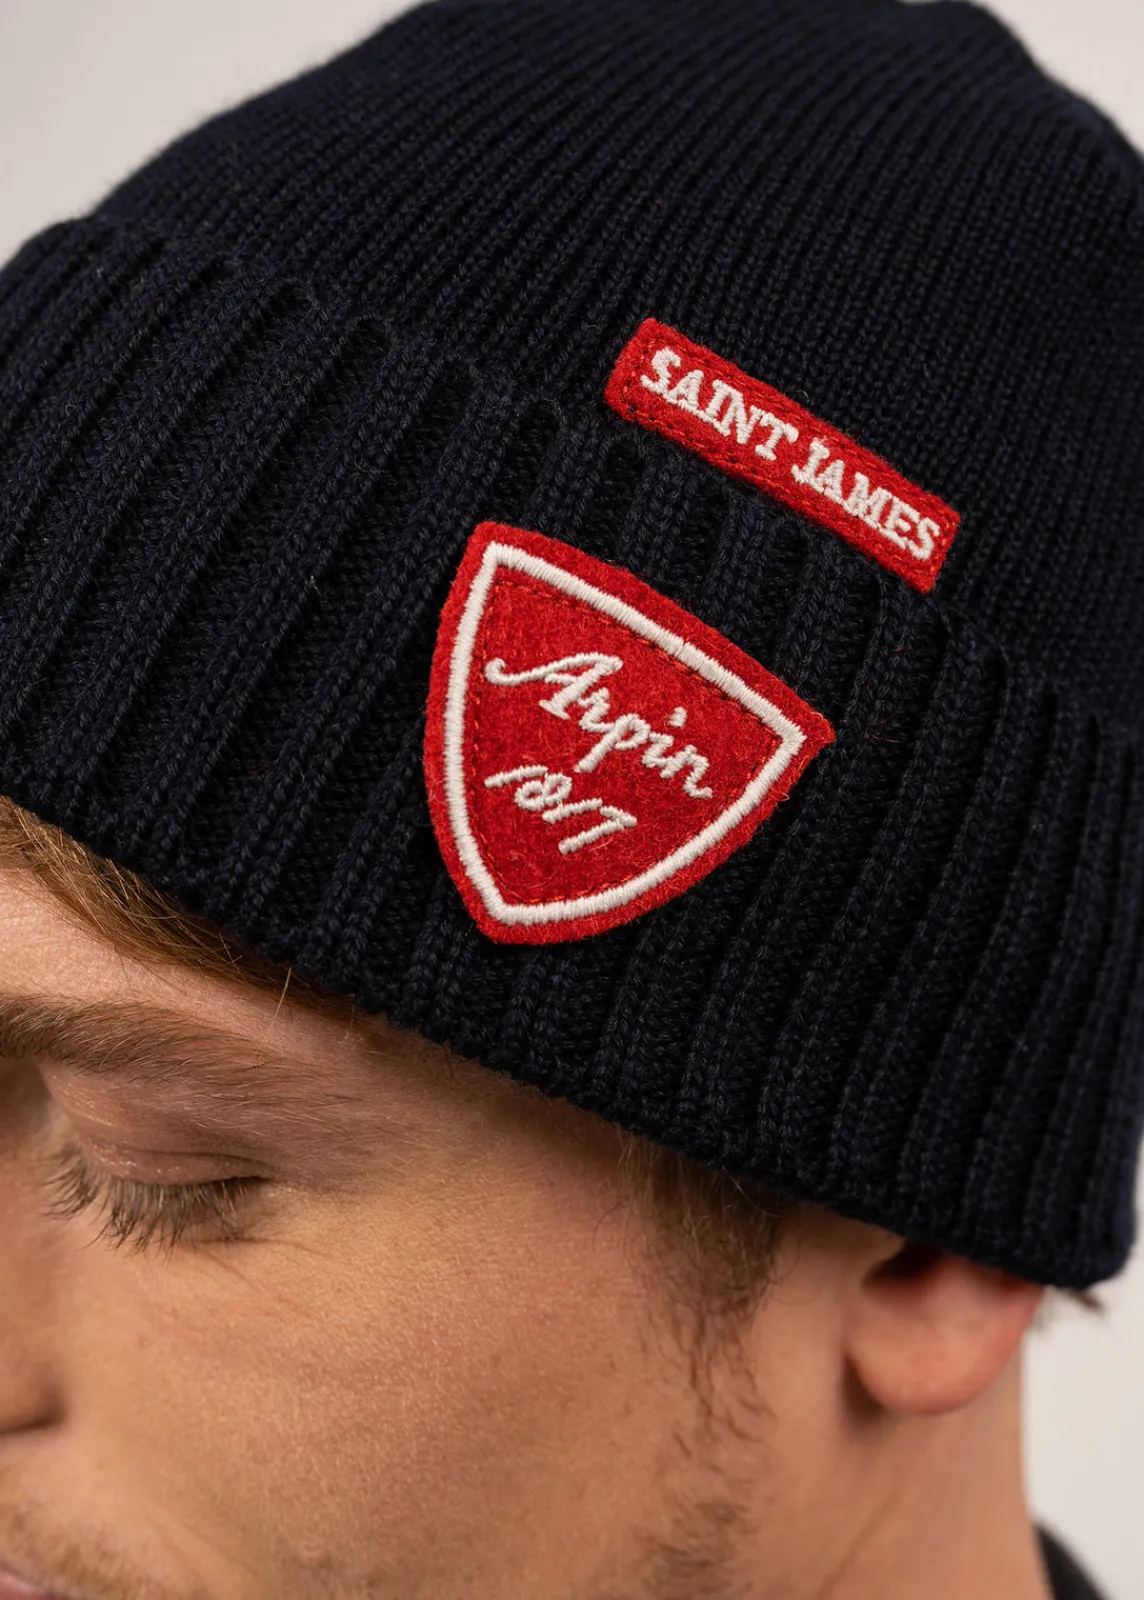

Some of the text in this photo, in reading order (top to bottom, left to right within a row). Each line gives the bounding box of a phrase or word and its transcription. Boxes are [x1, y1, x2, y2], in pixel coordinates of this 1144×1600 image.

[640, 346, 940, 561] SAINT JAMES
[484, 652, 713, 798] Arpin
[484, 764, 637, 855] 1817
